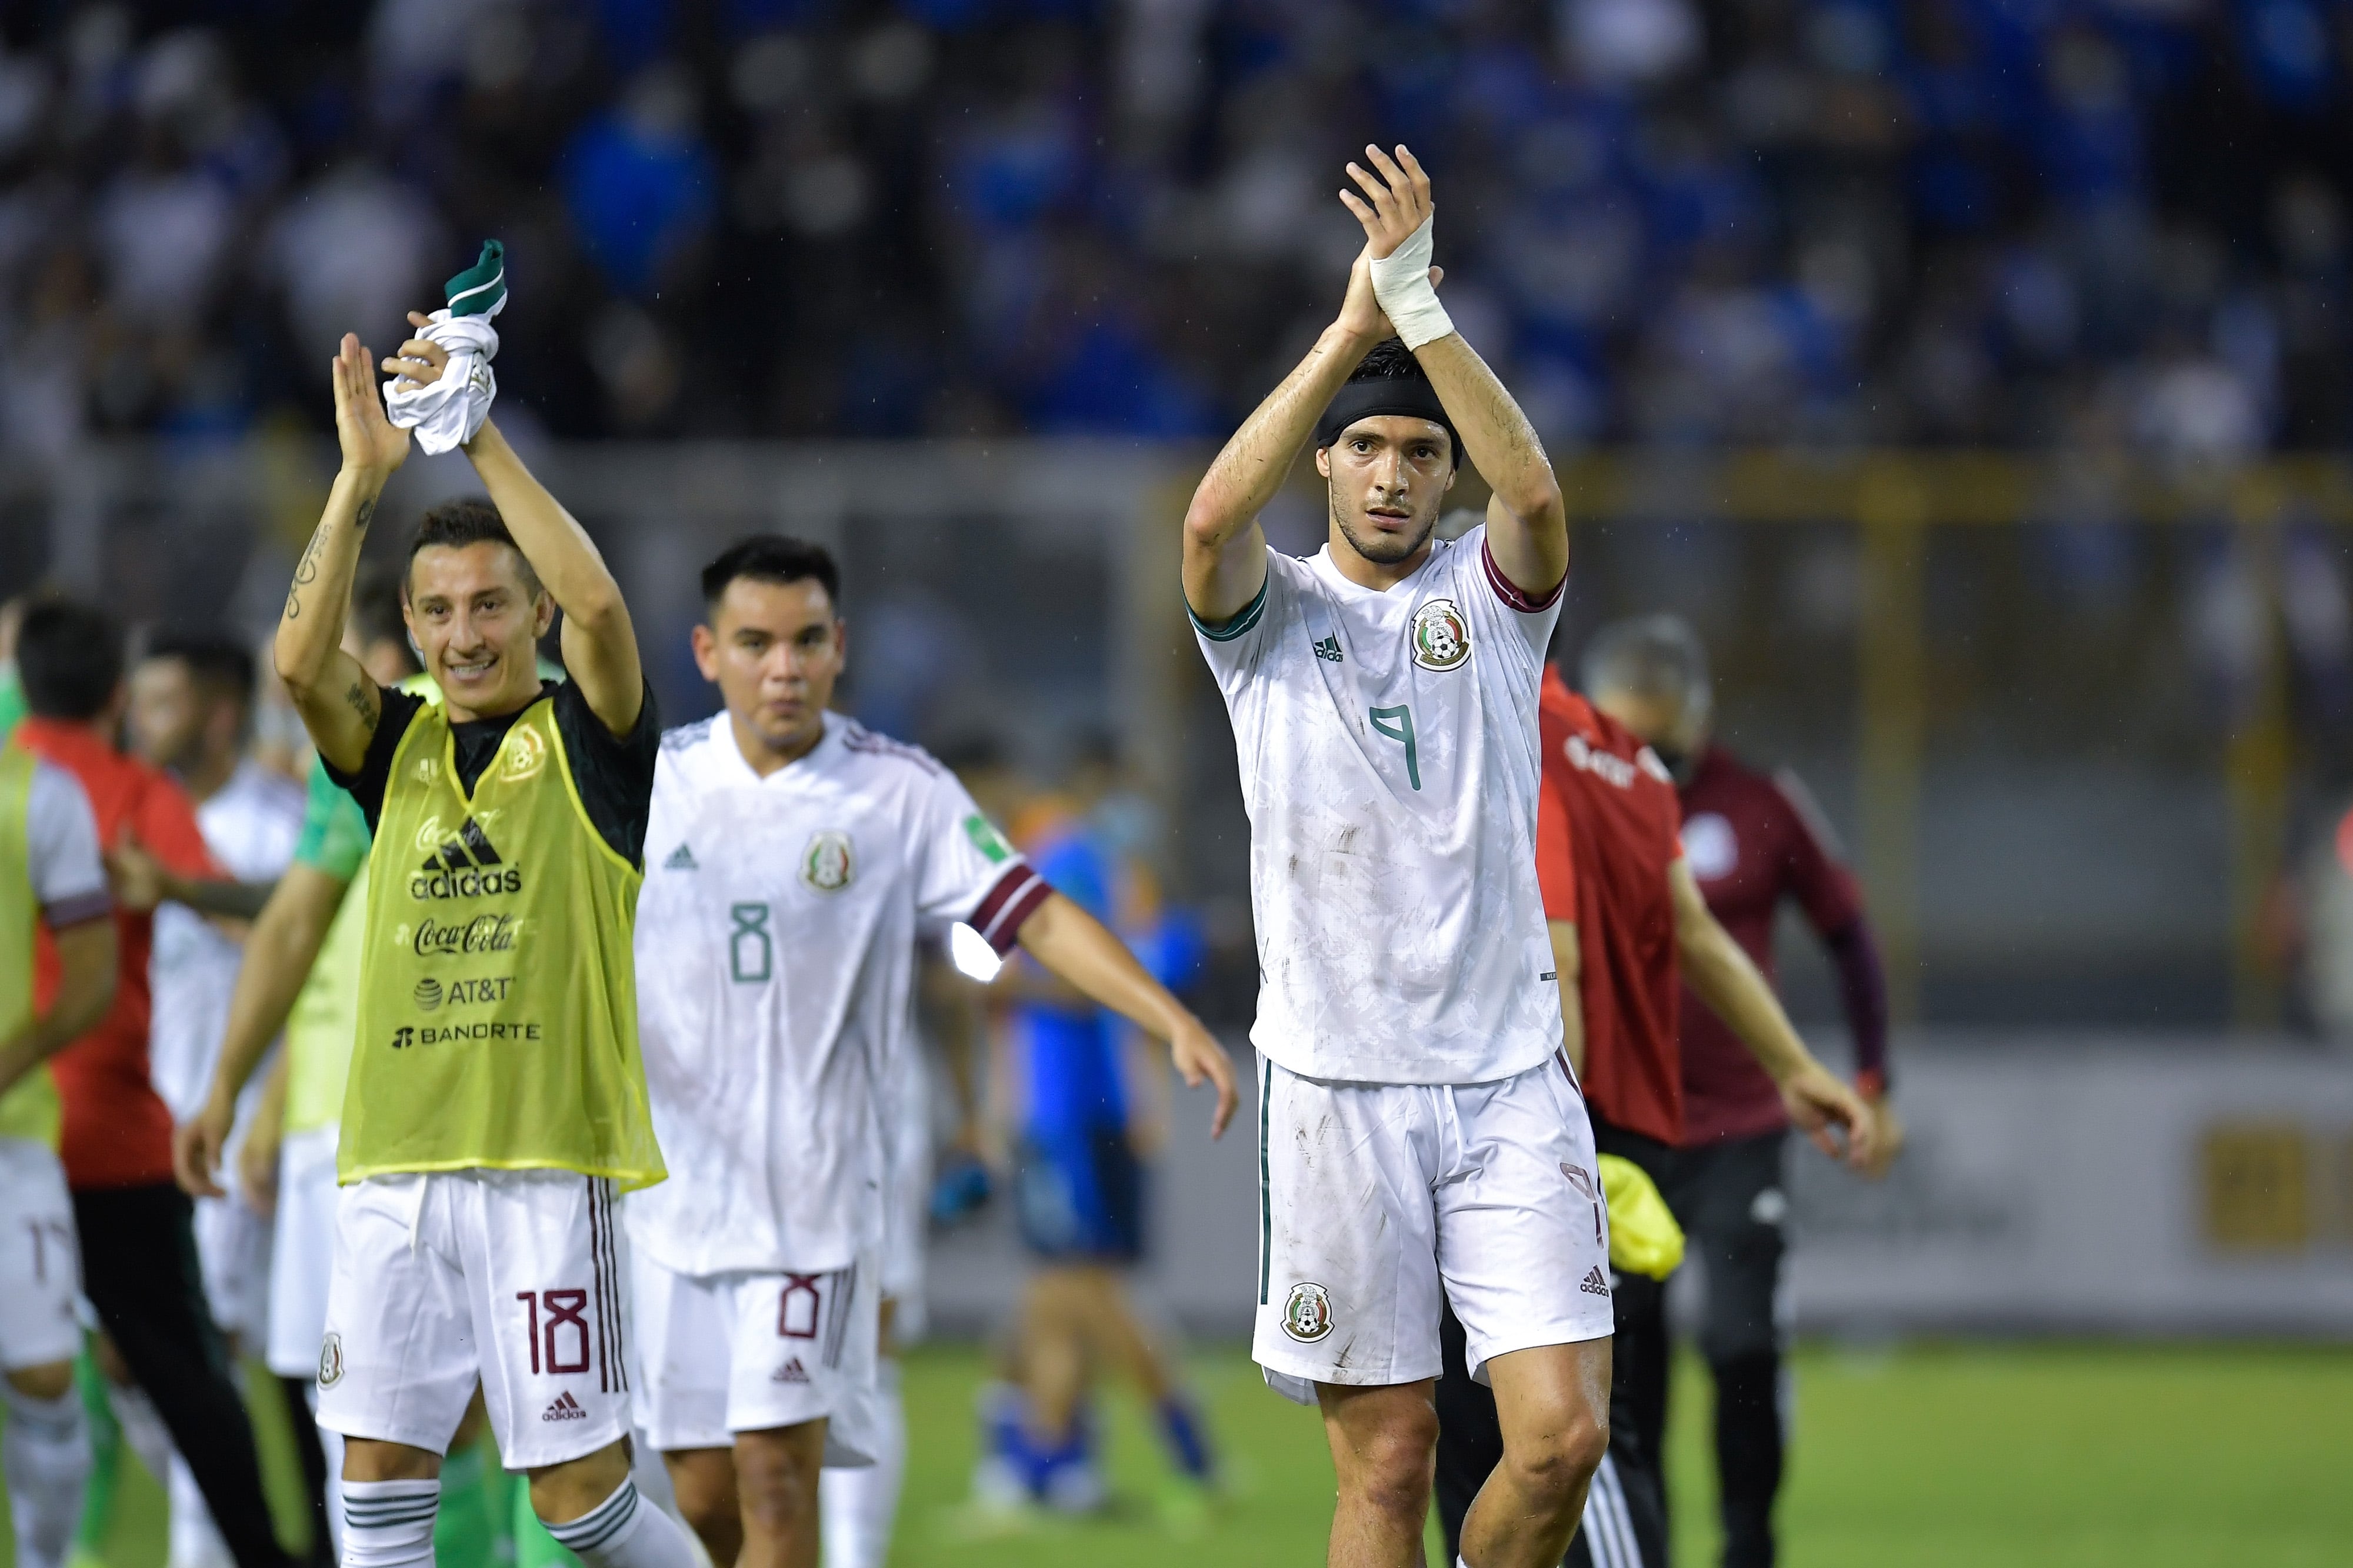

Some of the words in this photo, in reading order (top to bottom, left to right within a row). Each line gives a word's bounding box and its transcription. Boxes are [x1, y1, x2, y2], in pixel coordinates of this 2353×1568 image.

[1369, 705, 1421, 791] 9
[411, 867, 521, 900] adidas
[414, 914, 514, 956] Coca-Cola
[730, 902, 772, 983] 8
[448, 977, 511, 1005] AT&T
[421, 1023, 541, 1044] BANORTE
[1580, 1282, 1609, 1297] adidas
[516, 1289, 589, 1374] 18
